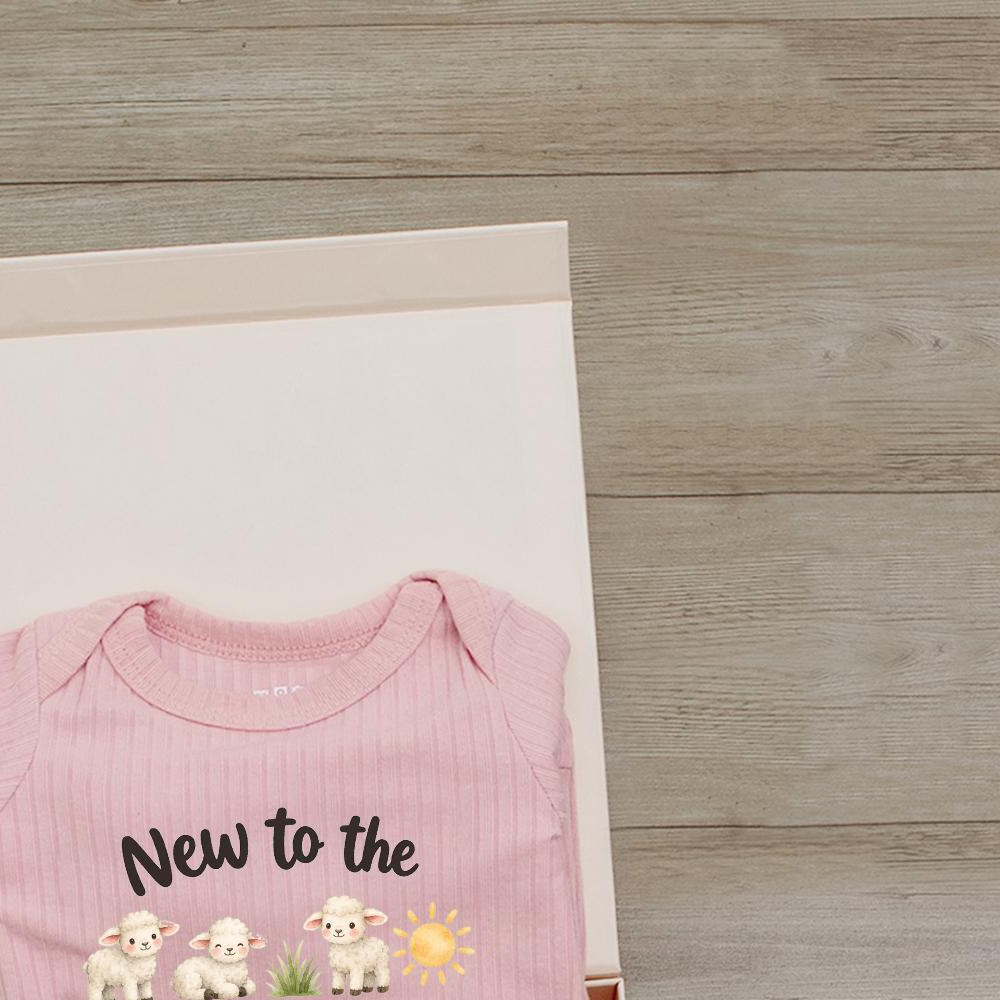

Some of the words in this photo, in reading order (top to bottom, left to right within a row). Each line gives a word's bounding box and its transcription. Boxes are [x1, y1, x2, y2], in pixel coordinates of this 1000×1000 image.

[121, 822, 249, 897] New
[264, 807, 325, 871] to
[339, 815, 420, 877] the
